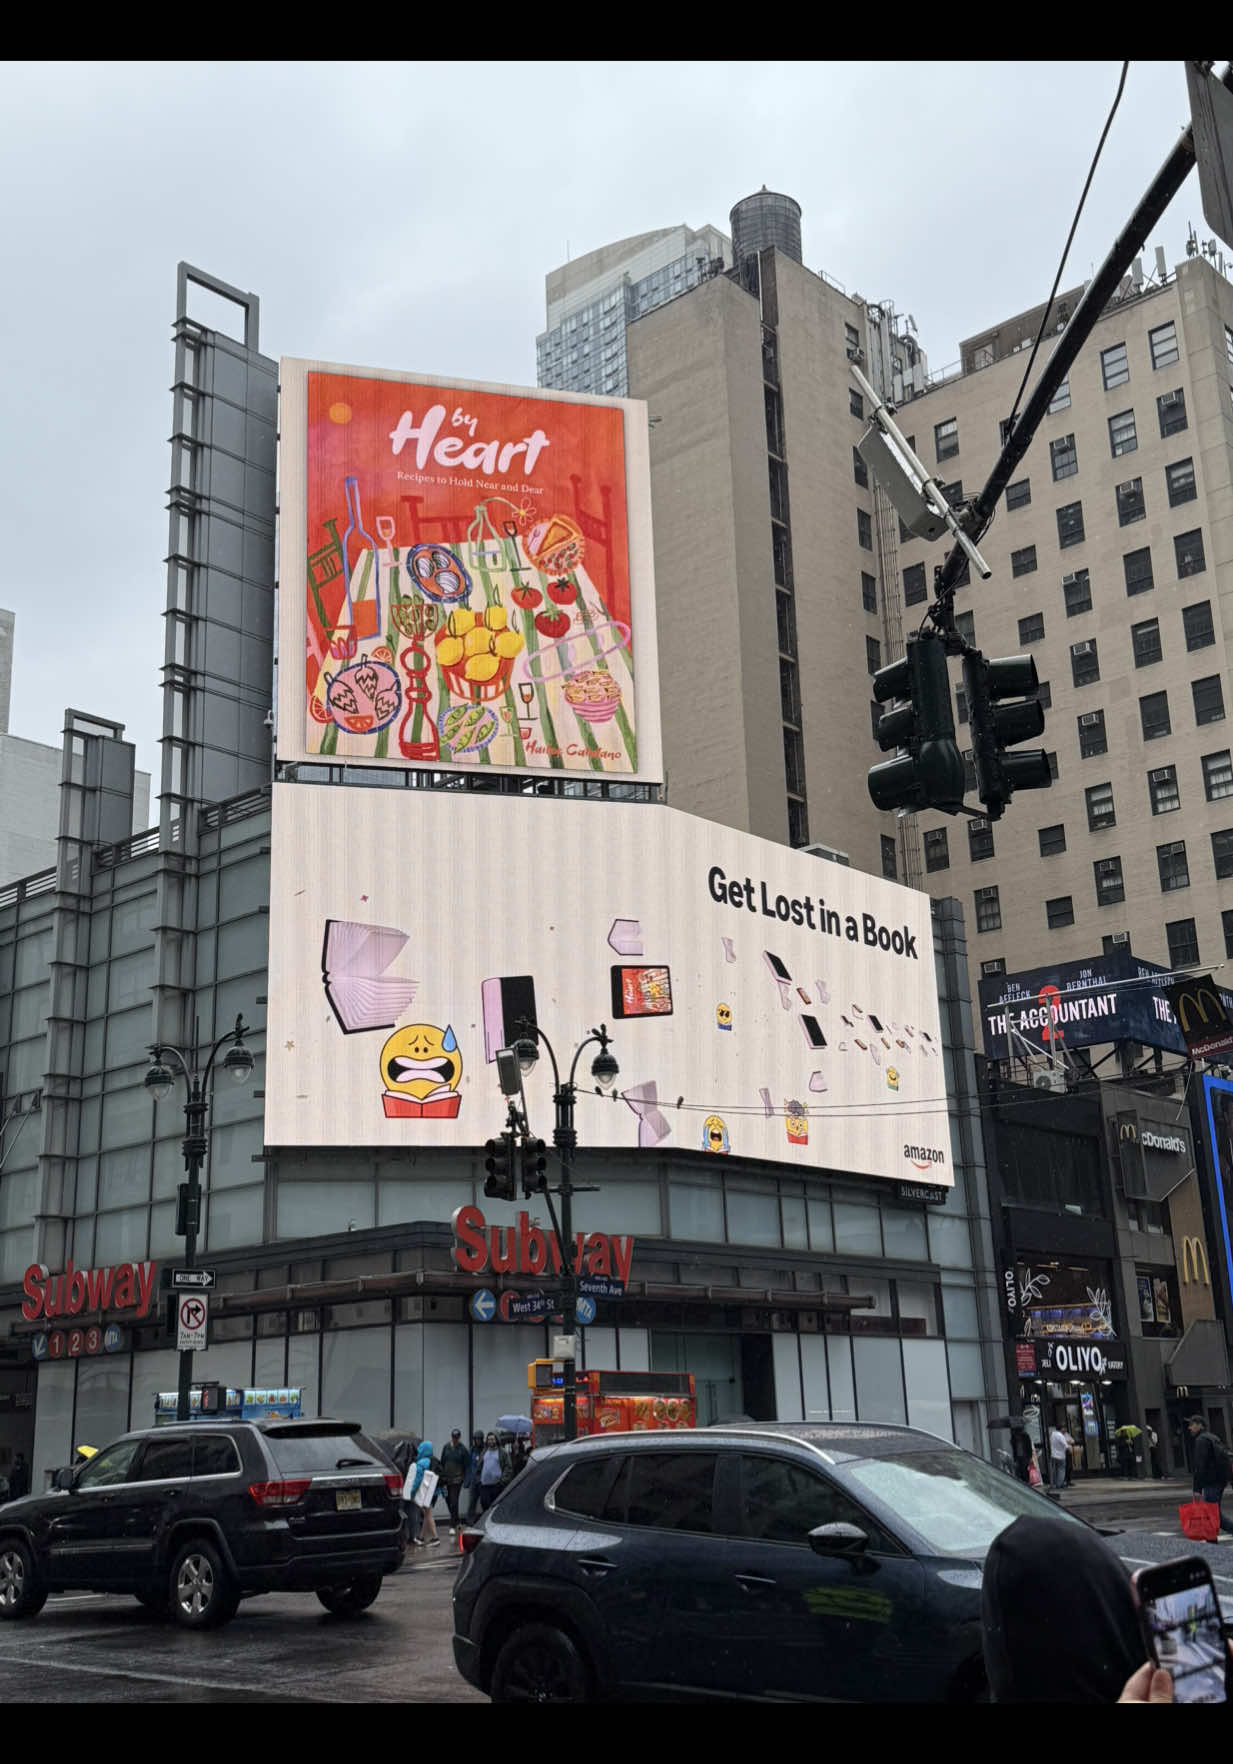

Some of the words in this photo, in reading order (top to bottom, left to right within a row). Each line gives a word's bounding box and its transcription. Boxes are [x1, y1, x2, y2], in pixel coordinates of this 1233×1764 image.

[452, 407, 478, 437] by
[389, 404, 550, 475] Heart
[397, 471, 435, 485] Recipes
[437, 475, 447, 485] to
[449, 476, 473, 488] Hold
[476, 479, 499, 491] Near
[501, 482, 519, 492] and
[521, 484, 545, 495] Dear
[708, 866, 757, 913] Get
[760, 881, 817, 930] Lost
[819, 898, 841, 937] in
[845, 914, 859, 943] a
[862, 912, 918, 960] Book
[1079, 968, 1093, 980] JON
[1007, 983, 1021, 993] BEN
[1020, 993, 1117, 1031] ACCOUNTANT
[1038, 984, 1064, 1041] 2
[1152, 996, 1172, 1023] THE
[903, 1144, 945, 1164] amazon
[22, 1260, 156, 1320] Subway
[580, 1280, 608, 1294] Seventh
[609, 1285, 623, 1296] Ave
[1004, 1271, 1017, 1308] OLIYO
[512, 1302, 531, 1313] West
[546, 1300, 555, 1310] St
[53, 1336, 60, 1353] 1
[71, 1333, 80, 1352] 2
[88, 1331, 97, 1349] 3
[1056, 1345, 1101, 1371] OLIYO
